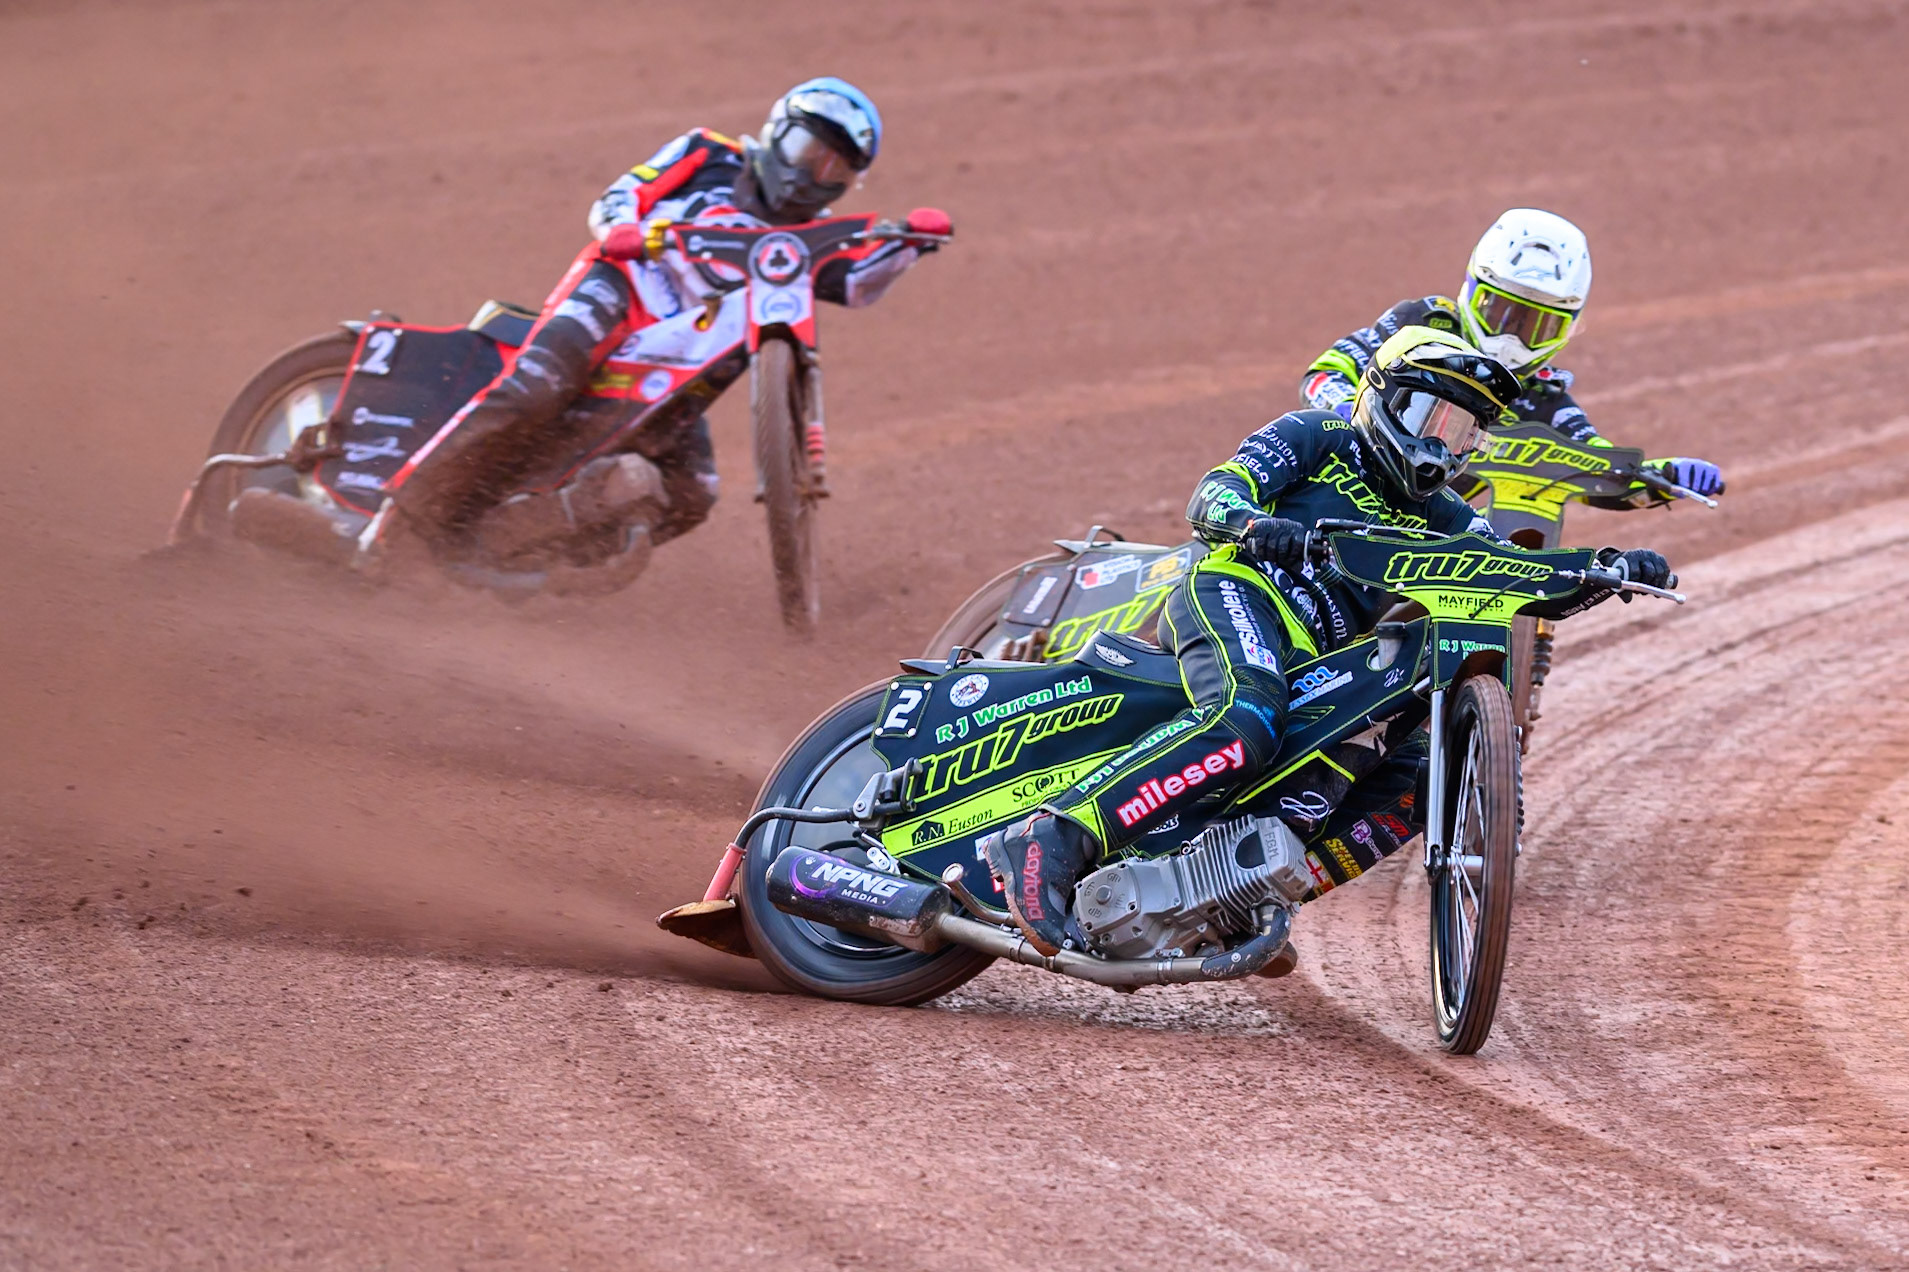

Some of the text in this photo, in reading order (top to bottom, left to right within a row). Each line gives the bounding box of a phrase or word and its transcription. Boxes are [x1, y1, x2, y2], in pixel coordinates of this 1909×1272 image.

[361, 330, 397, 375] 2
[1438, 594, 1504, 608] MAYFIELD
[1439, 639, 1450, 652] R
[1451, 640, 1459, 653] J
[883, 690, 923, 729] 2
[936, 723, 955, 744] R
[957, 716, 969, 738] J
[972, 688, 1054, 727] Warren
[1054, 675, 1093, 699] Ltd
[1012, 768, 1080, 803] SCOTT
[1115, 739, 1246, 829] milesey
[948, 808, 994, 834] Euston
[811, 861, 909, 898] NPNG
[841, 888, 878, 904] MEDIA
[1023, 840, 1045, 921] daytona
